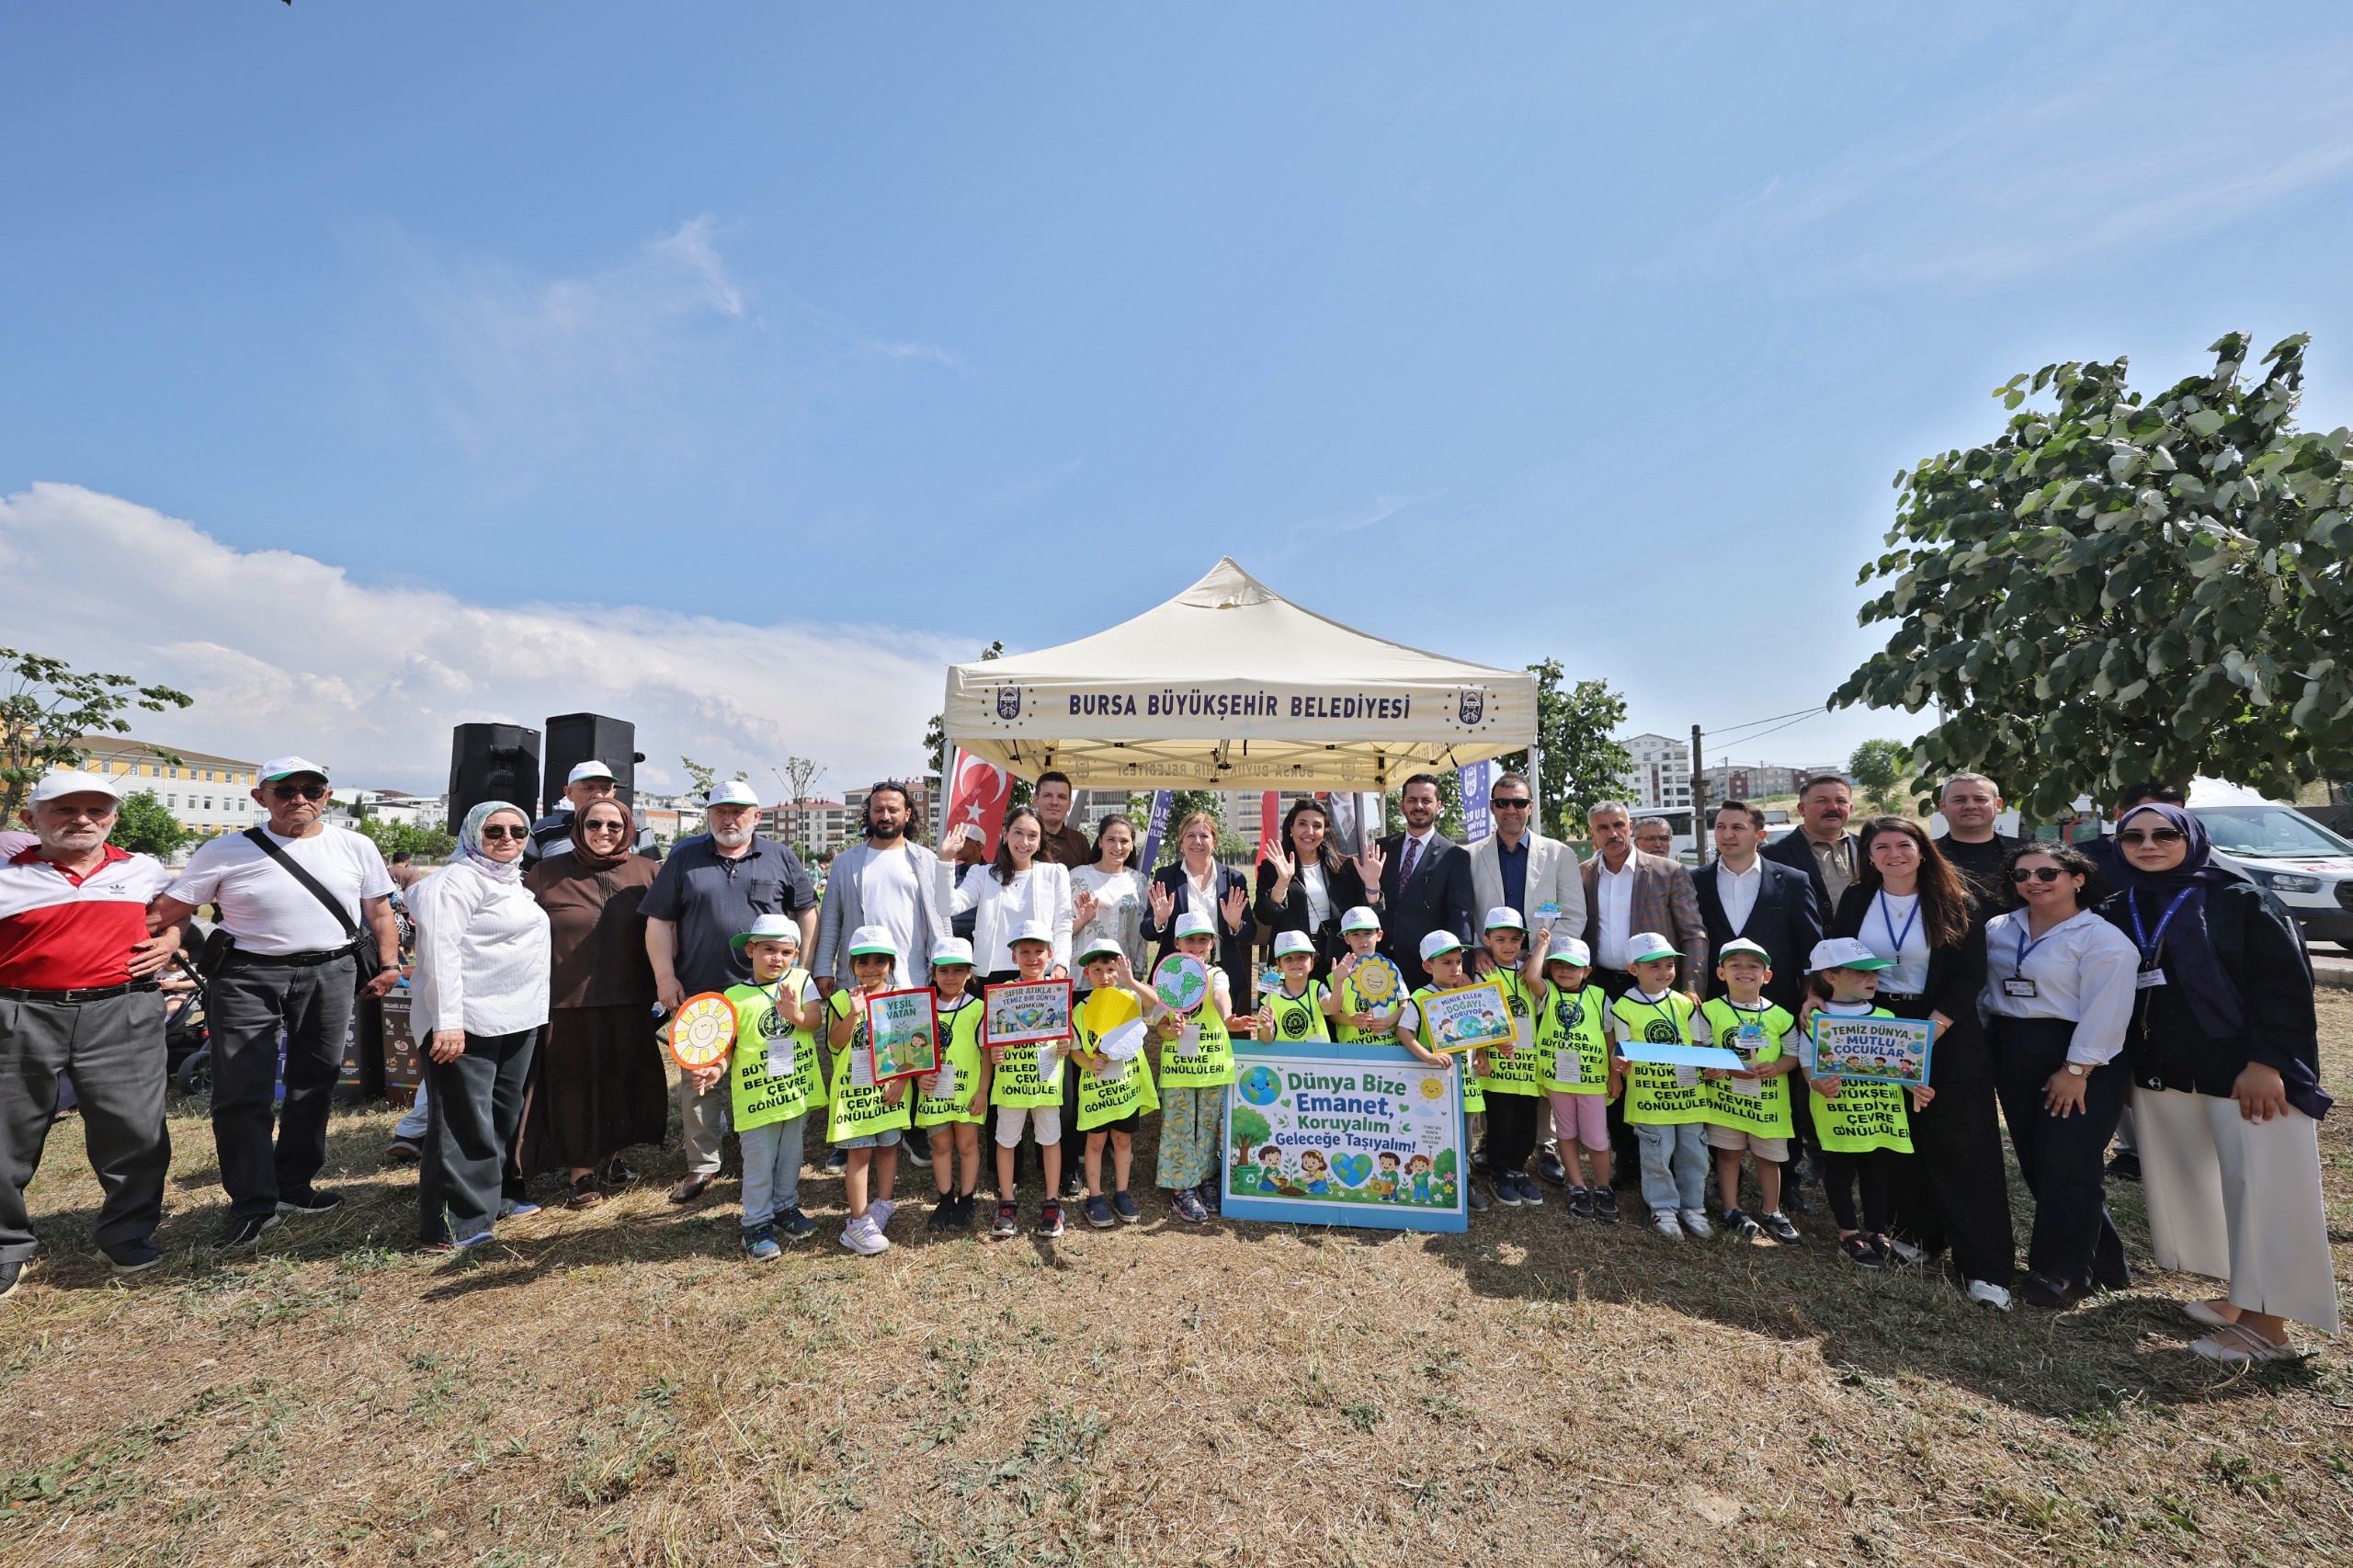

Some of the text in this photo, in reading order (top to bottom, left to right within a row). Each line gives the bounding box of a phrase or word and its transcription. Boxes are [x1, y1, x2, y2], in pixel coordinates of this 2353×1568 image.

[1069, 688, 1410, 721] BURSA BÜYÜKŞEHİR BELEDİYESİ
[1005, 986, 1051, 998] SIFIR ATIKLA
[888, 997, 914, 1011] YEŞİL
[1003, 995, 1022, 1006] TEMİZ
[1441, 995, 1461, 1006] MİNİK
[1446, 1000, 1482, 1014] DOĞAYI
[886, 1008, 916, 1020] VATAN
[1449, 1008, 1483, 1020] KORUYOR
[1831, 1024, 1912, 1040] TEMİZ DÜNYA,
[1847, 1036, 1895, 1047] MUTLU
[1834, 1045, 1905, 1058] ÇOCUKLAR
[1173, 1055, 1208, 1065] ÇEVRE
[1499, 1062, 1534, 1072] ÇEVRE
[767, 1075, 806, 1096] ÇEVRE
[1098, 1082, 1130, 1099] ÇEVRE
[1288, 1073, 1406, 1096] Dünya Bize
[1654, 1088, 1697, 1101] ÇEVRE
[1717, 1092, 1763, 1110] ÇEVRE
[1296, 1093, 1394, 1119] Emanet,
[1297, 1115, 1390, 1135] Koruyalım
[1847, 1112, 1894, 1126] ÇEVRE
[1275, 1131, 1416, 1153] Geleceğe Taşıyalım!
